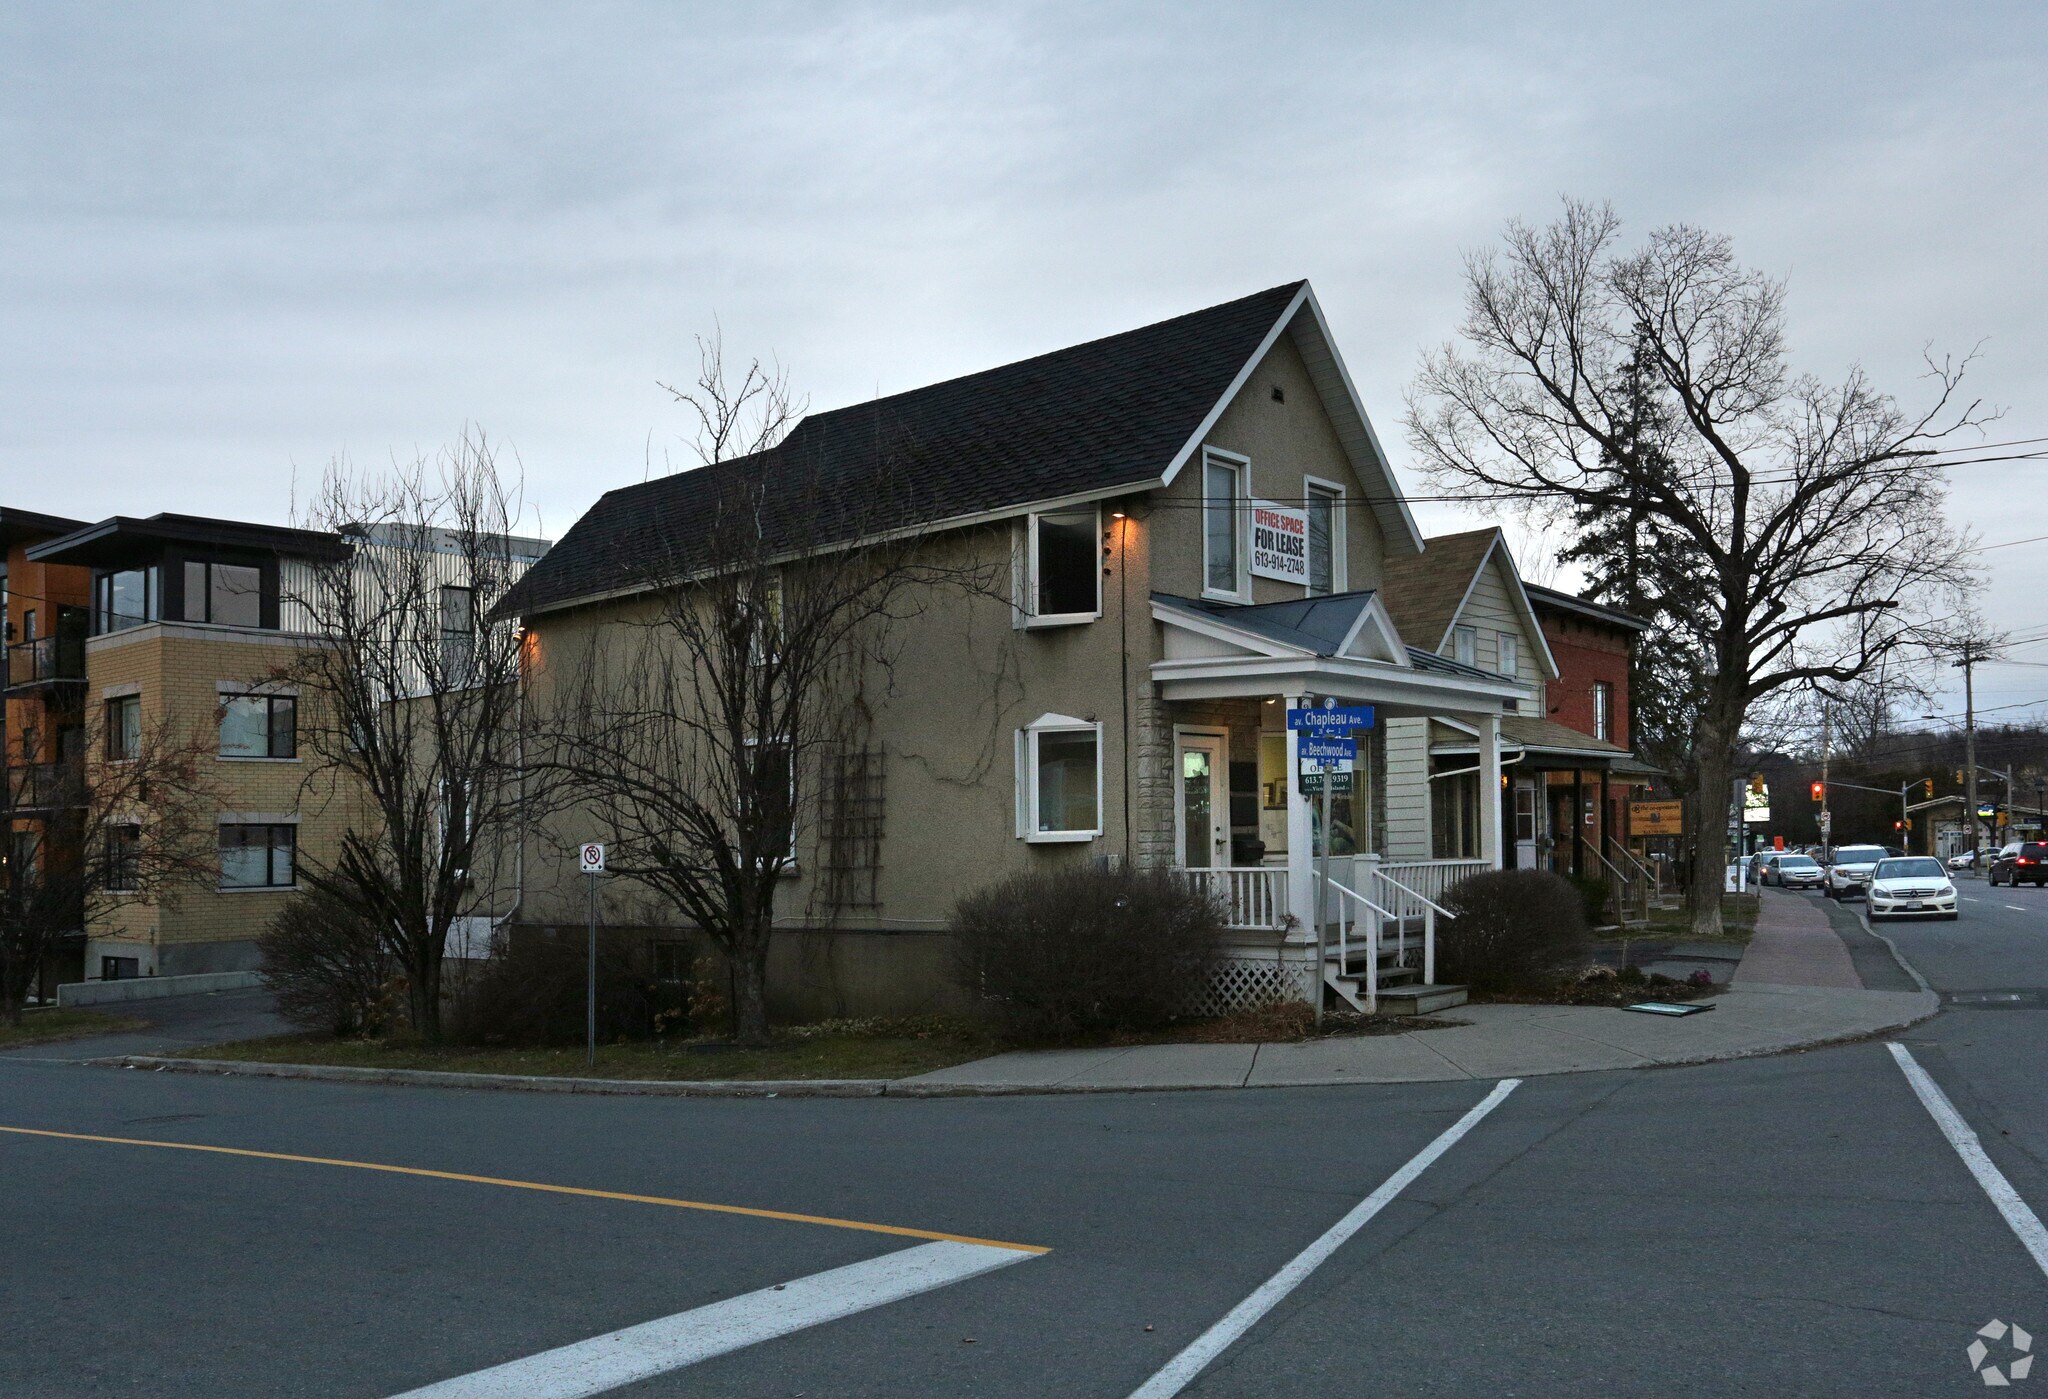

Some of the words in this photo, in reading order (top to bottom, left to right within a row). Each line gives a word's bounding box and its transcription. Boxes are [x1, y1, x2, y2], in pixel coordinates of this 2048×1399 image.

[1255, 509, 1280, 529] OFFICE
[1280, 515, 1304, 535] SPACE
[1255, 527, 1274, 551] FOR
[1276, 532, 1304, 558] LEASE
[1255, 550, 1305, 575] 613-914-2748
[1305, 711, 1347, 729] Chapleau
[1349, 716, 1363, 724] Ave.
[1309, 742, 1344, 757] Beechwood
